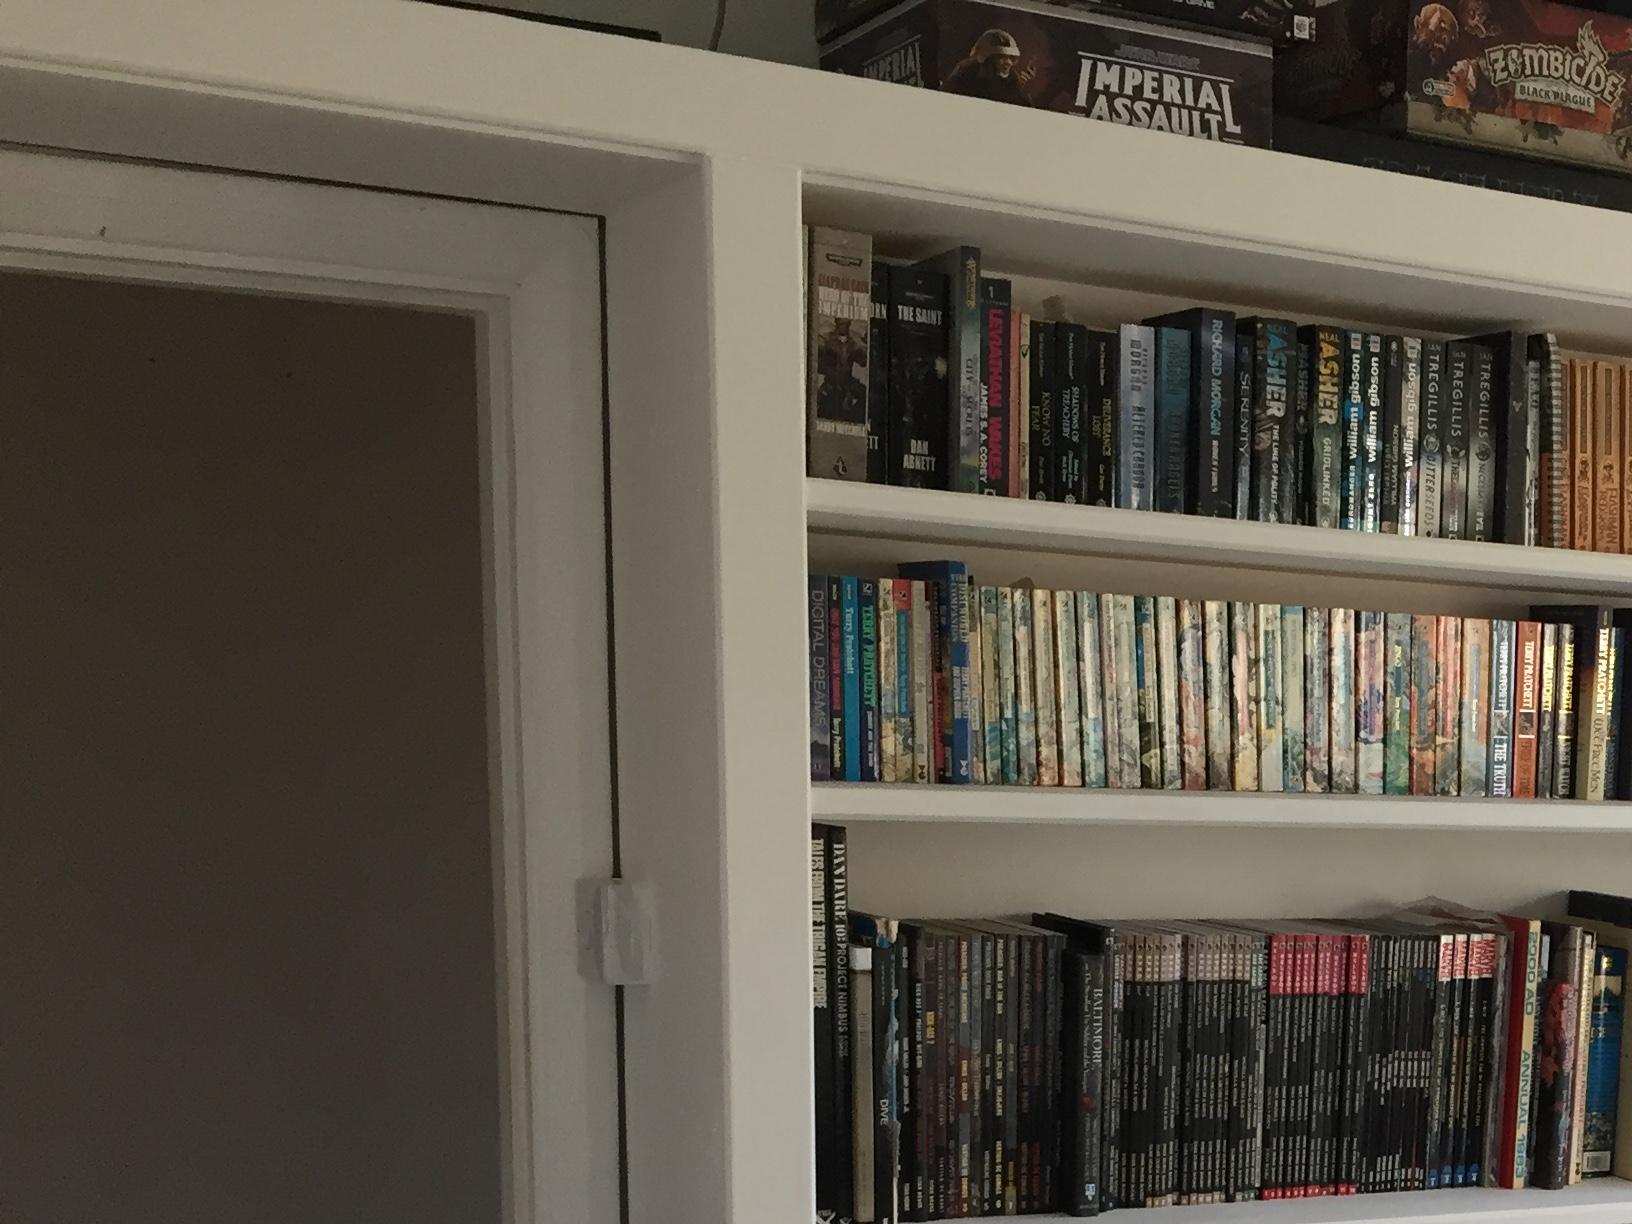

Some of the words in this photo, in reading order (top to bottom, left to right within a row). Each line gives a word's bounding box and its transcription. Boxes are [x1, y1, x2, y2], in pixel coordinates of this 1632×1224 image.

[1487, 24, 1626, 107] ZOMBICIDE
[1075, 60, 1243, 134] IMPERIAL
[1518, 84, 1551, 100] BLACK
[1552, 88, 1593, 108] PLAGUE
[1092, 98, 1224, 142] ASSAULT
[897, 304, 914, 321] THE
[915, 307, 943, 326] SAINT
[988, 308, 1004, 408] LEVIATHAN
[1210, 319, 1224, 377] RICHARD
[1265, 333, 1287, 419] ASHER
[1318, 341, 1338, 425] ASHER
[1405, 362, 1417, 412] gibson
[1426, 353, 1440, 430] TREGILLIS
[1450, 360, 1464, 437] TREGILLIS
[979, 383, 989, 418] JAMES
[1041, 391, 1052, 427] KNOW
[1061, 389, 1071, 438] TREACHERY
[1209, 378, 1224, 436] MORGAN
[1239, 371, 1251, 458] SERENITY
[1478, 362, 1491, 439] TREGILLIS
[910, 439, 929, 454] DAN
[1042, 429, 1051, 447] NO
[1091, 415, 1101, 436] LOST
[1102, 398, 1112, 457] DELIVERANCE
[1403, 415, 1416, 467] william
[902, 453, 936, 472] ABNETT
[979, 446, 989, 484] COREY
[987, 417, 1003, 481] WAKES
[1321, 437, 1332, 505] GRIDLINKED
[811, 589, 826, 652] DIGITAL
[862, 605, 874, 641] TERRY
[1599, 628, 1610, 658] TERRY
[1523, 641, 1534, 664] TERRY
[812, 656, 827, 727] DREAMS
[862, 644, 875, 707] PRATCHETT
[1522, 664, 1533, 707] PRATCHETT
[1596, 659, 1609, 715] PRATCHETT
[1494, 743, 1507, 762] THE
[1493, 764, 1507, 796] TRUTH
[812, 839, 825, 868] TALES
[812, 902, 825, 924] THE
[832, 879, 845, 921] DARE
[836, 943, 848, 990] PROJECT
[1480, 939, 1495, 978] MARVEL
[1527, 931, 1538, 983] 2000
[812, 968, 826, 1009] EMPIRE
[1524, 986, 1536, 1016] AD
[836, 991, 848, 1033] NIMBUS
[1517, 1050, 1532, 1130] ANNUAL
[878, 1100, 889, 1126] DIVE
